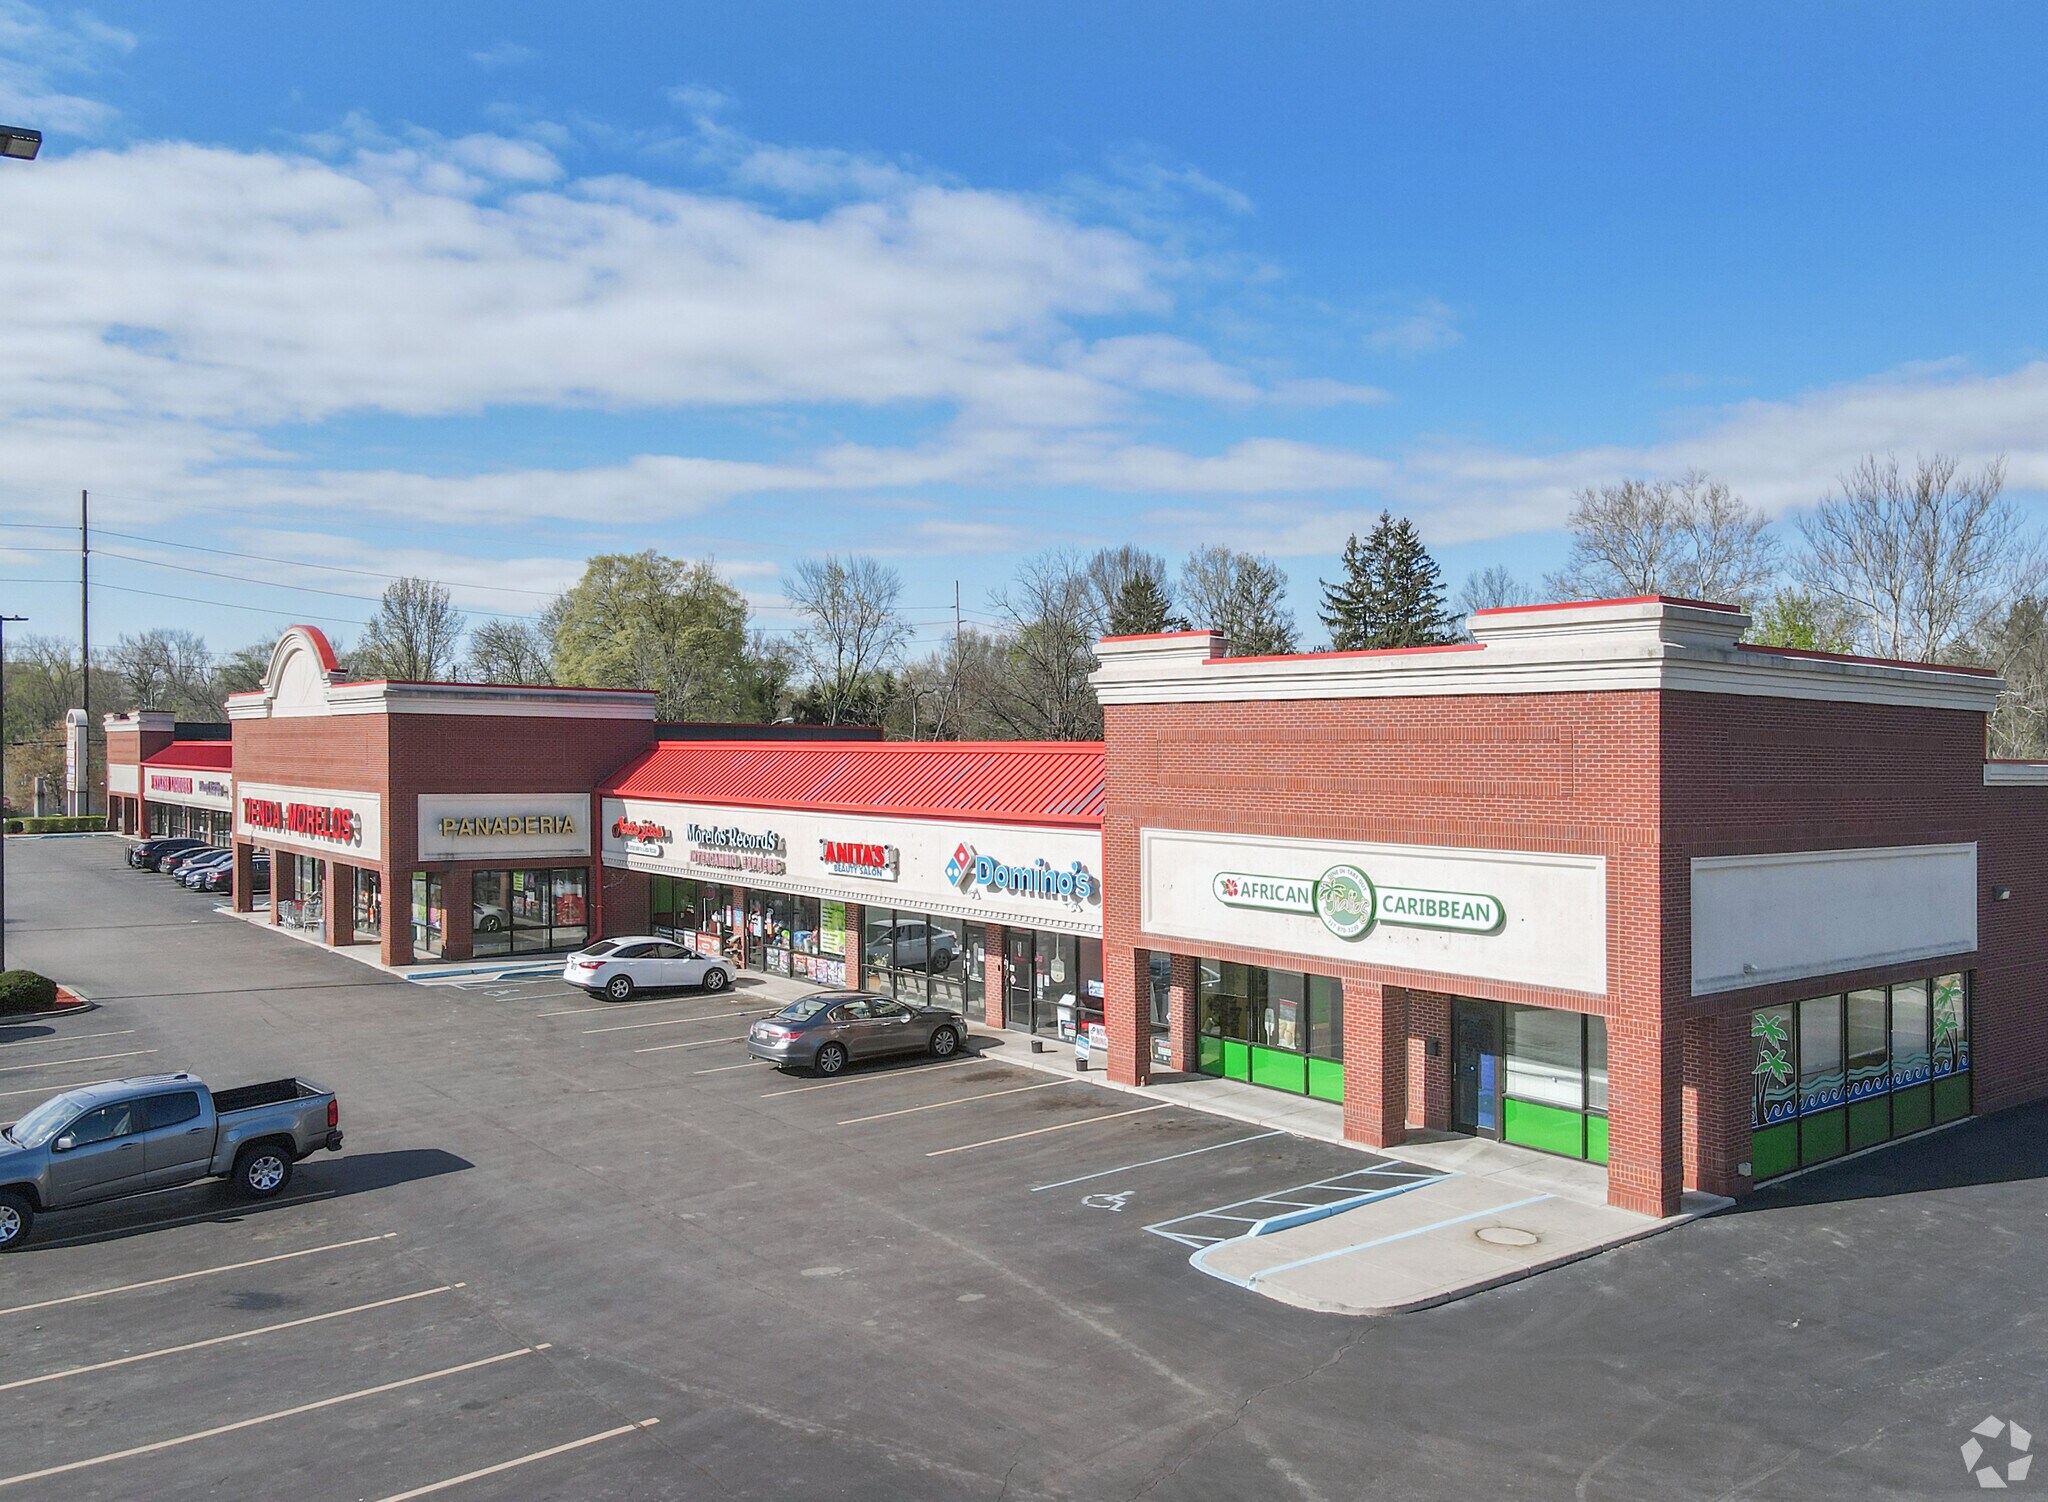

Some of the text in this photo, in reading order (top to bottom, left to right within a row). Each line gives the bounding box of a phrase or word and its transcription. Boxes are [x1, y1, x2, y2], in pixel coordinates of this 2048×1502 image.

[242, 798, 353, 841] TIENDA MORELOS
[442, 815, 576, 836] PANADERIA
[687, 824, 776, 850] Morelos Records
[825, 841, 885, 868] ANITA'S
[834, 864, 882, 877] BEAUTY SALON
[976, 855, 1091, 897] Domino's
[1240, 882, 1309, 904] AFRICAN
[1382, 895, 1490, 922] CARIBBEAN
